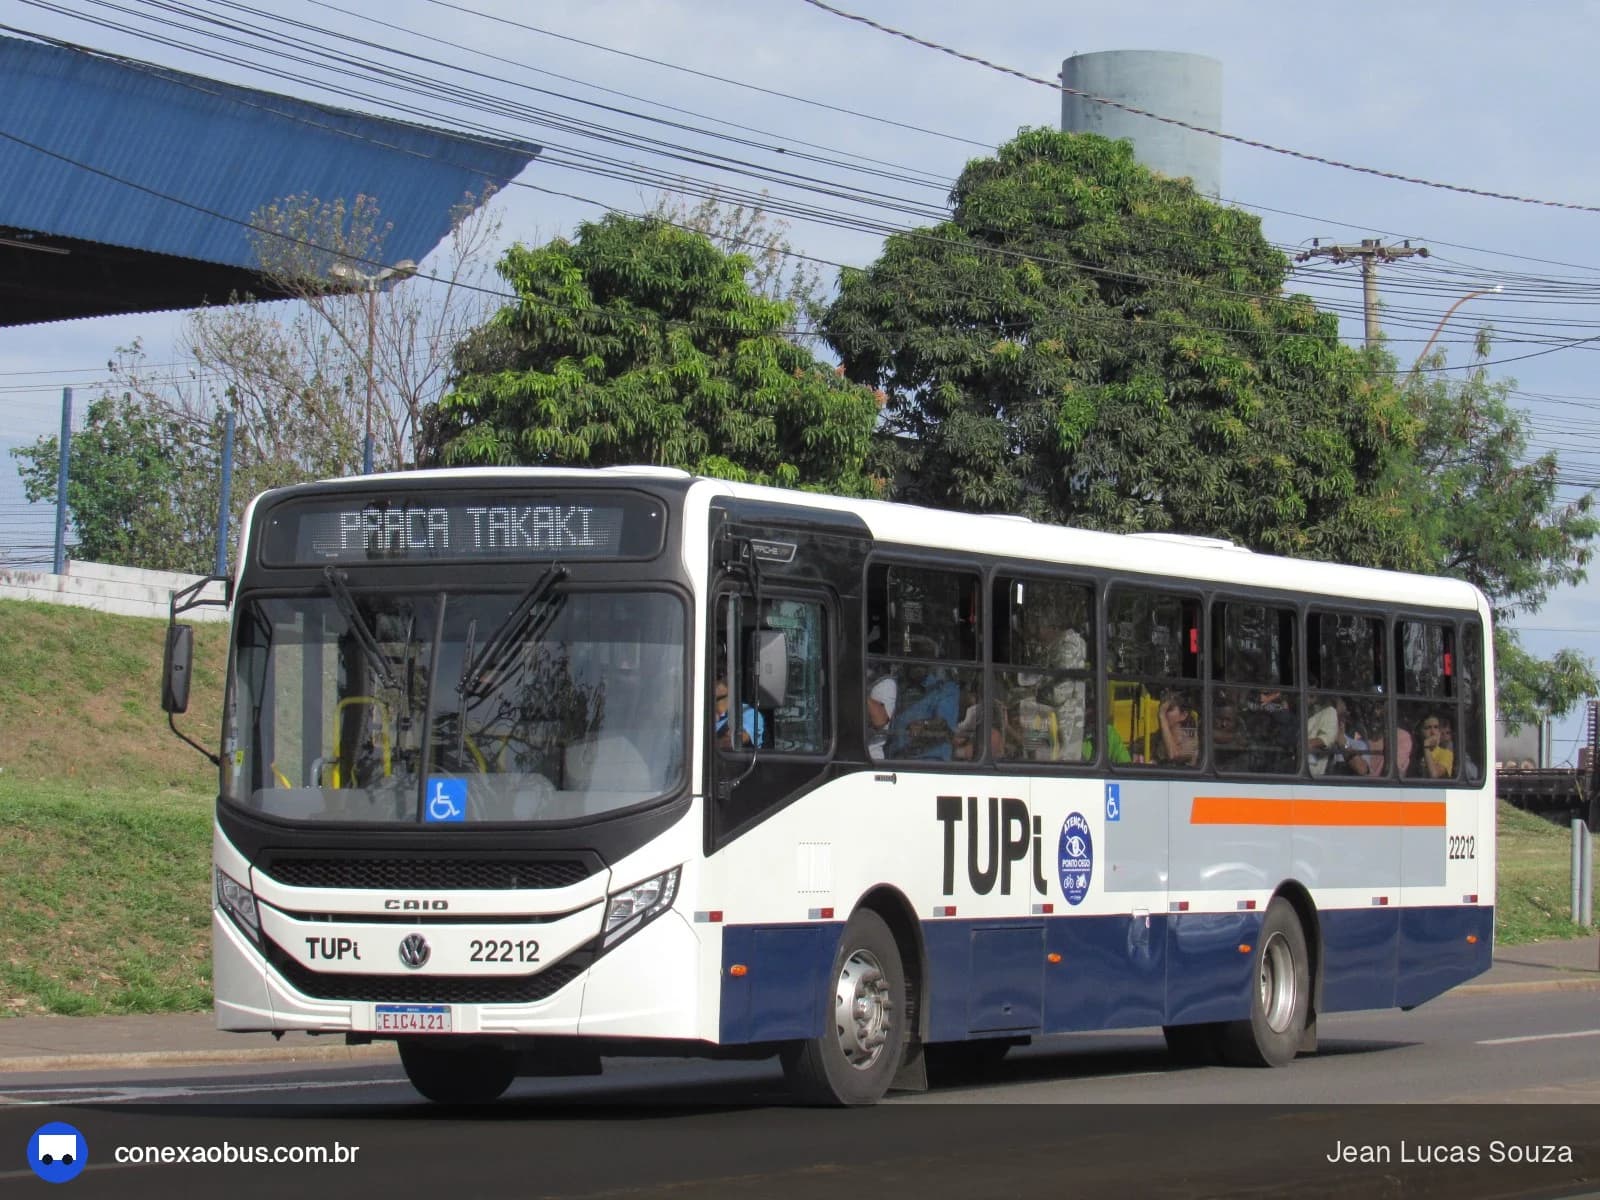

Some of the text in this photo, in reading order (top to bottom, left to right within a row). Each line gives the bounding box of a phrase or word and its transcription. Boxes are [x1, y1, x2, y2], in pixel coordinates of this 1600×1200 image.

[340, 506, 594, 549] PRACA TAKAKI
[1064, 815, 1088, 836] ATENÇÃO
[1449, 835, 1475, 860] 22212
[384, 899, 449, 910] CAIO
[469, 939, 540, 962] 22212
[383, 1013, 444, 1030] EIC4I21
